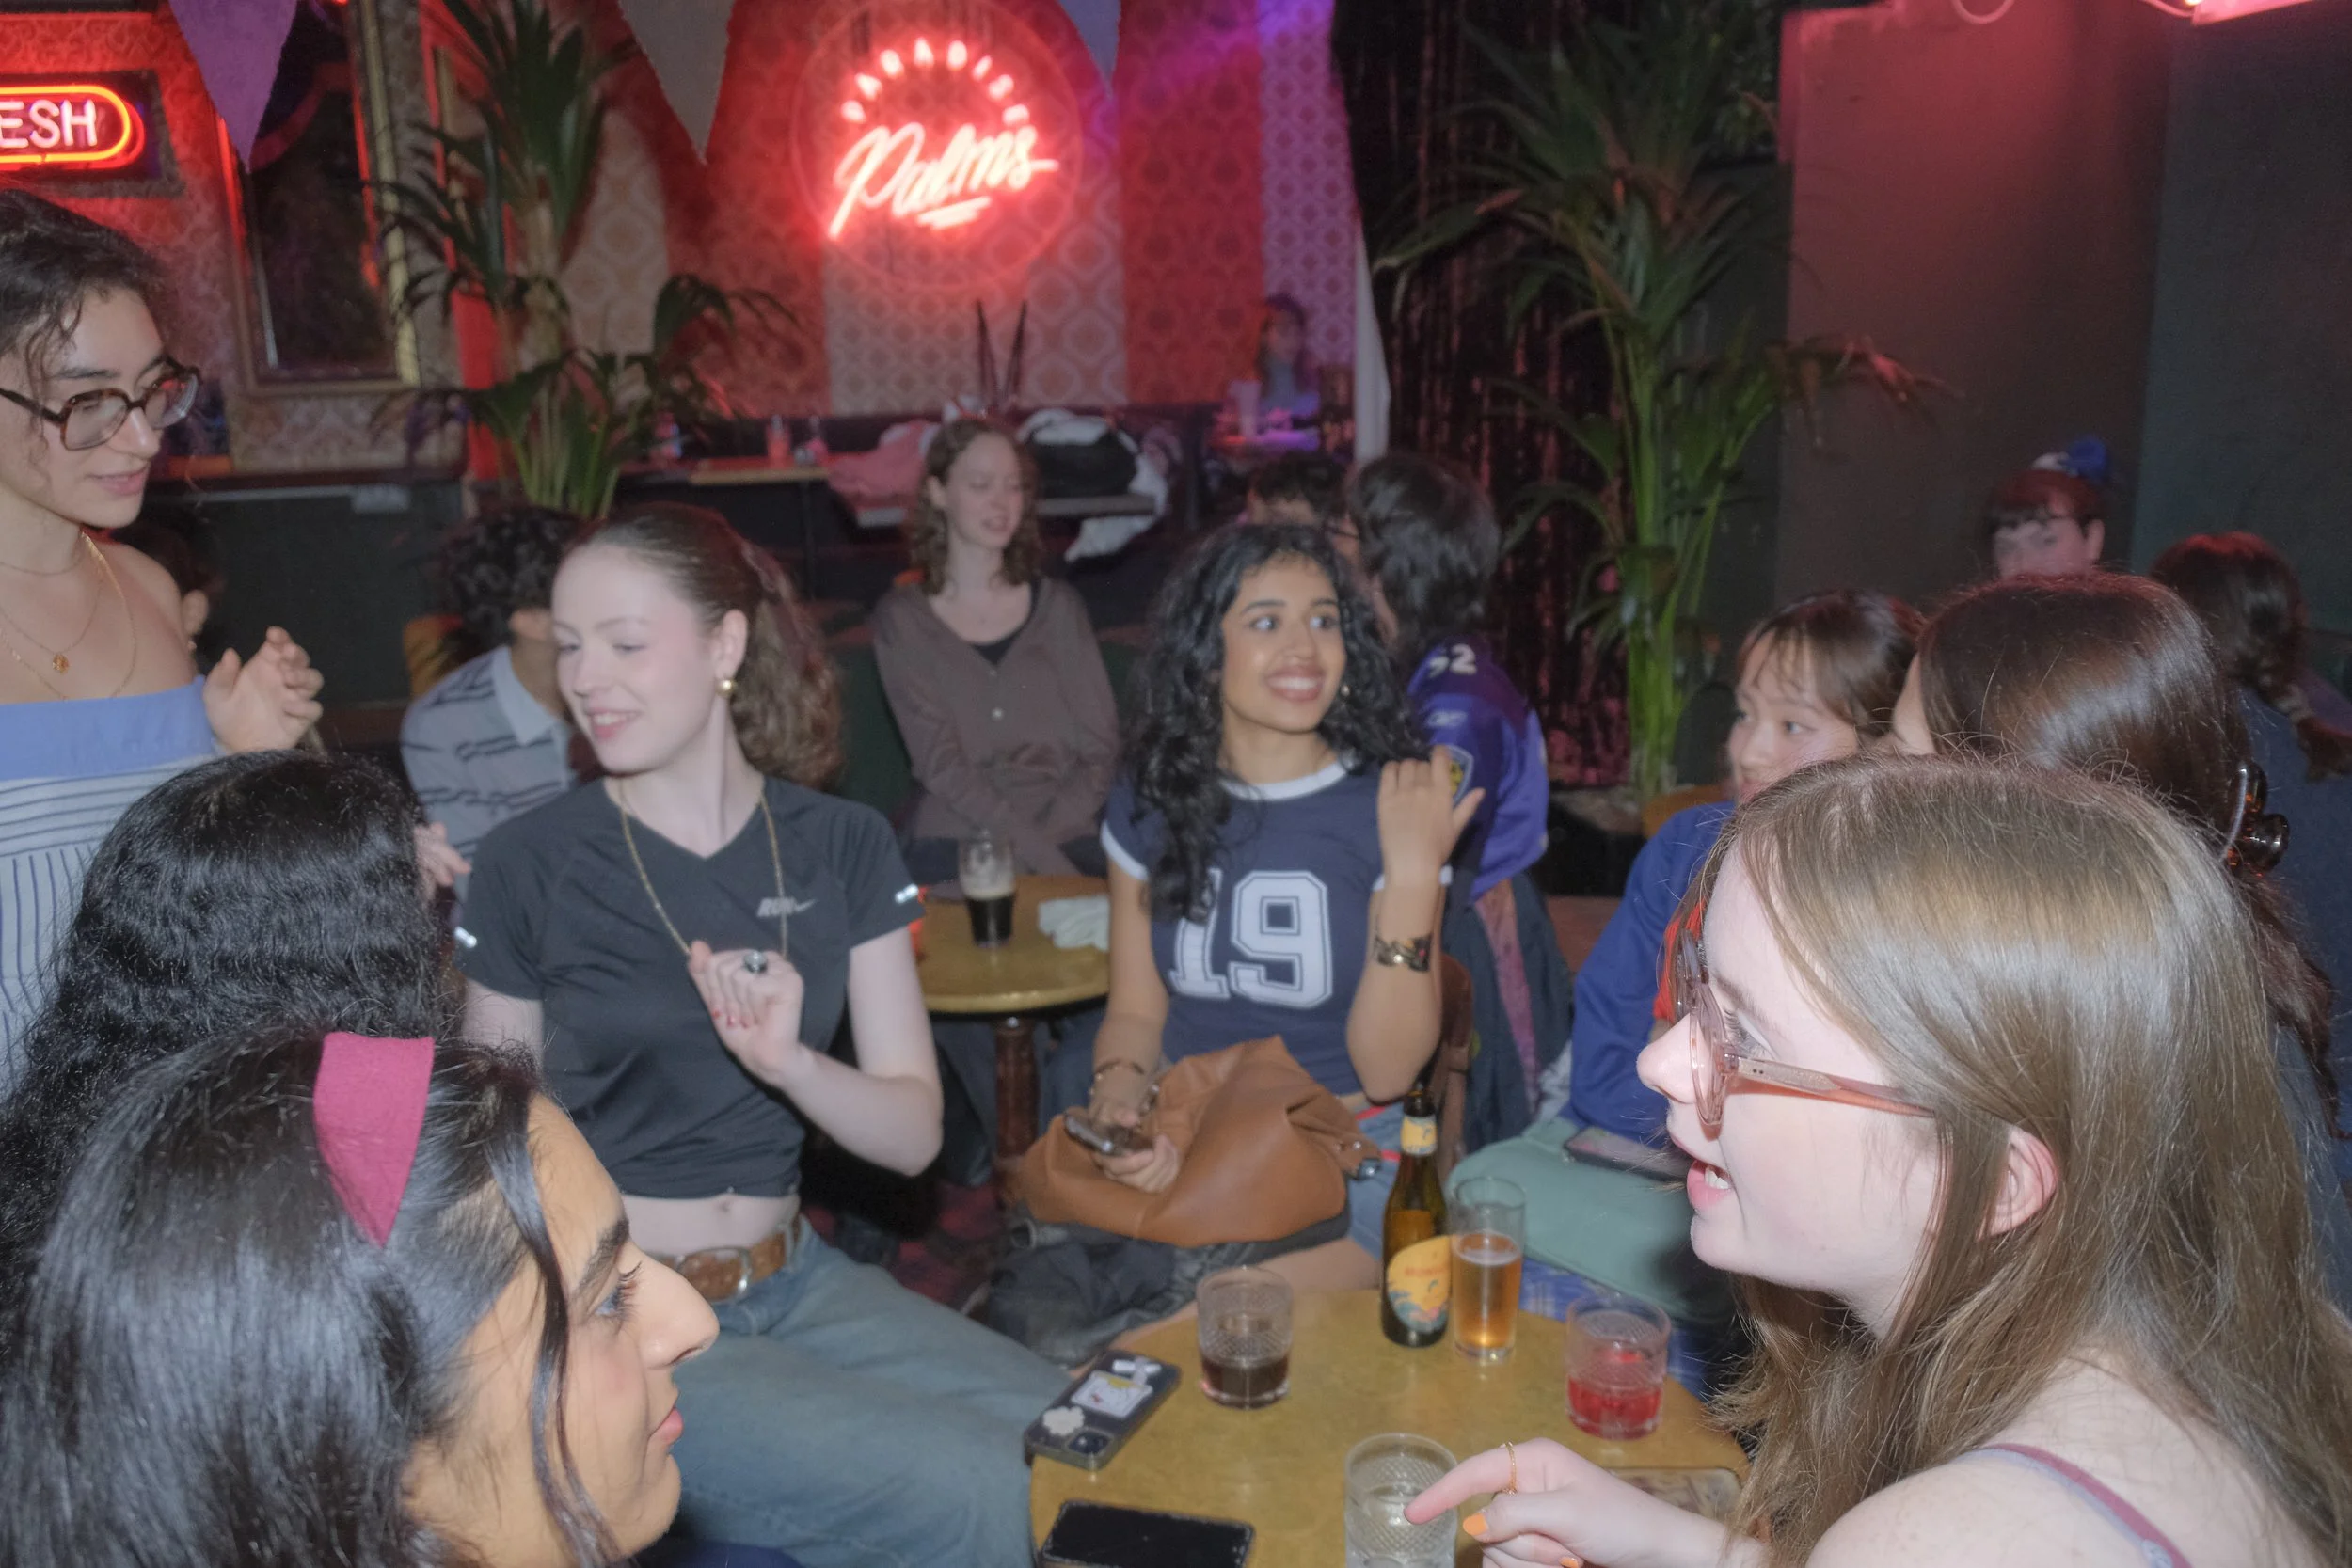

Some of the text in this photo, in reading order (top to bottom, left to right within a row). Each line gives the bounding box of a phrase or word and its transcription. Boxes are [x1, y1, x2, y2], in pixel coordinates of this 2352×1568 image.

[0, 99, 97, 148] ESH
[827, 122, 1058, 242] Palms
[1168, 867, 1333, 1009] 19
